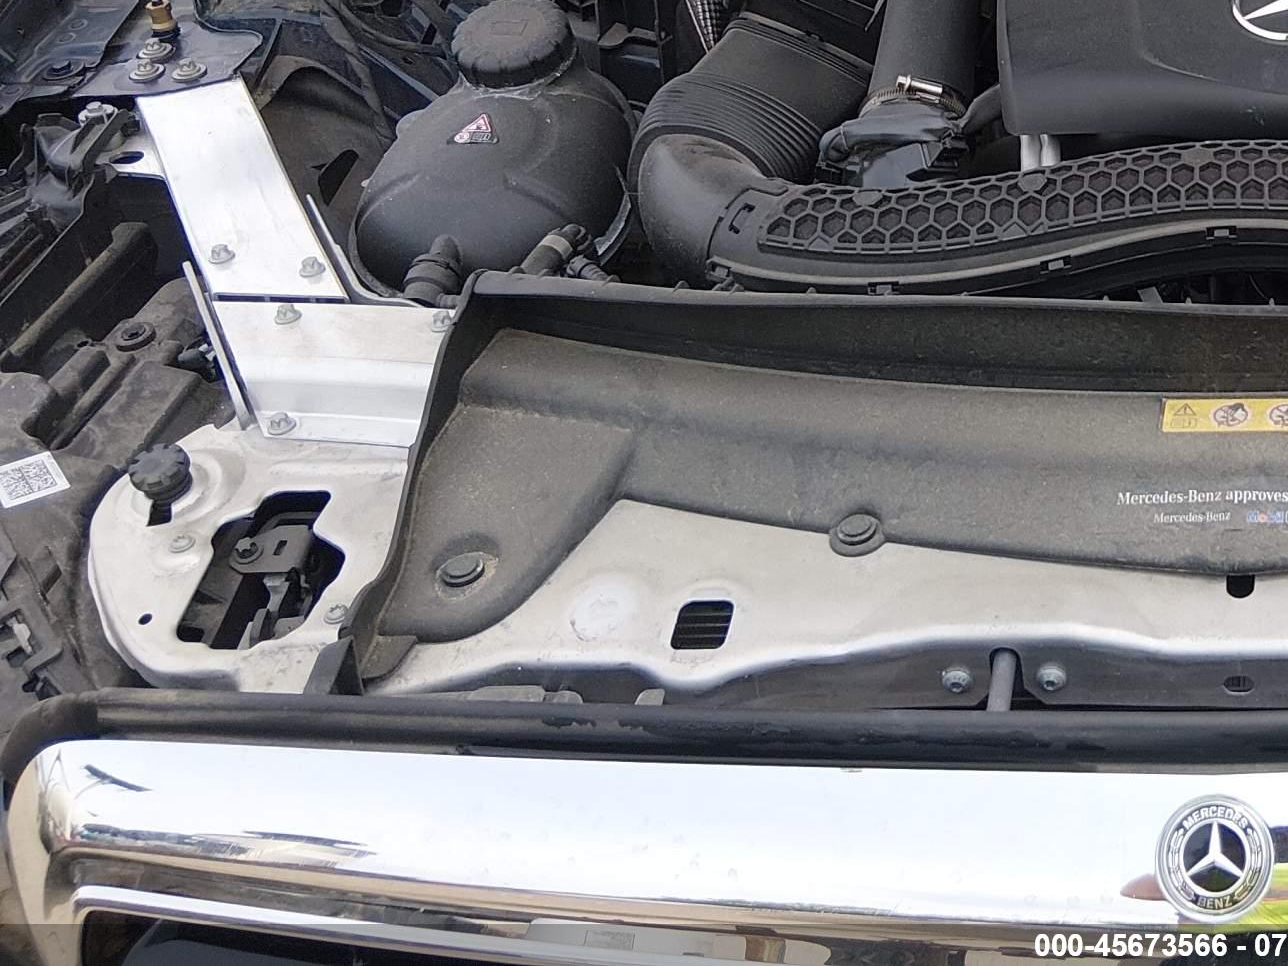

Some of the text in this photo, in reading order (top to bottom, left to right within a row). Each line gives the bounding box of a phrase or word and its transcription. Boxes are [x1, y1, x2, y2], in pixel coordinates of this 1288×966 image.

[1117, 489, 1222, 506] Mercedes-Benz
[1225, 489, 1288, 504] approves
[1153, 511, 1231, 523] Mercedes-Benz
[1182, 805, 1249, 831] MERCEDES
[1197, 894, 1233, 910] BENZ
